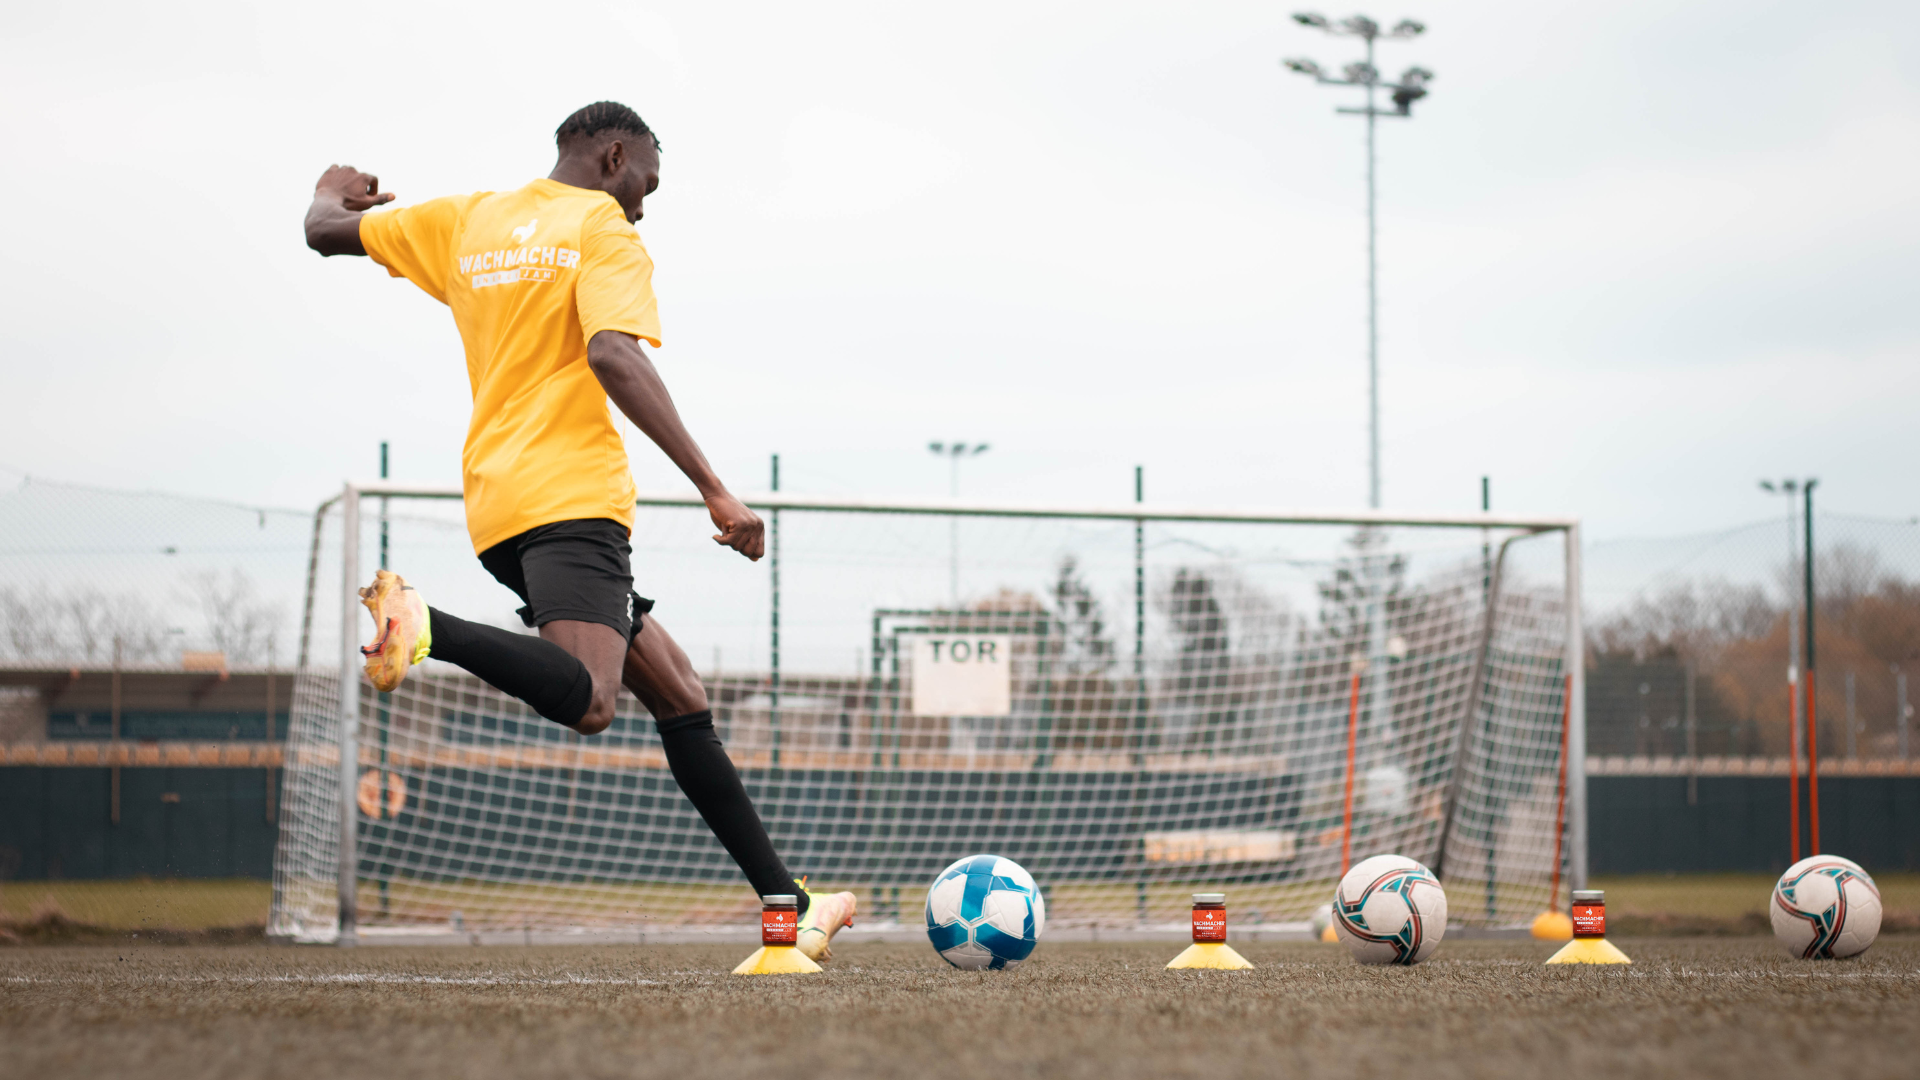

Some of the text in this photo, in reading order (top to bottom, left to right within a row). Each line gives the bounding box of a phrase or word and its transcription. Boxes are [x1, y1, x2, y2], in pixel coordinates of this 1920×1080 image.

[459, 246, 581, 275] WACHMACHER
[523, 270, 551, 279] JAM
[928, 640, 997, 662] TOR
